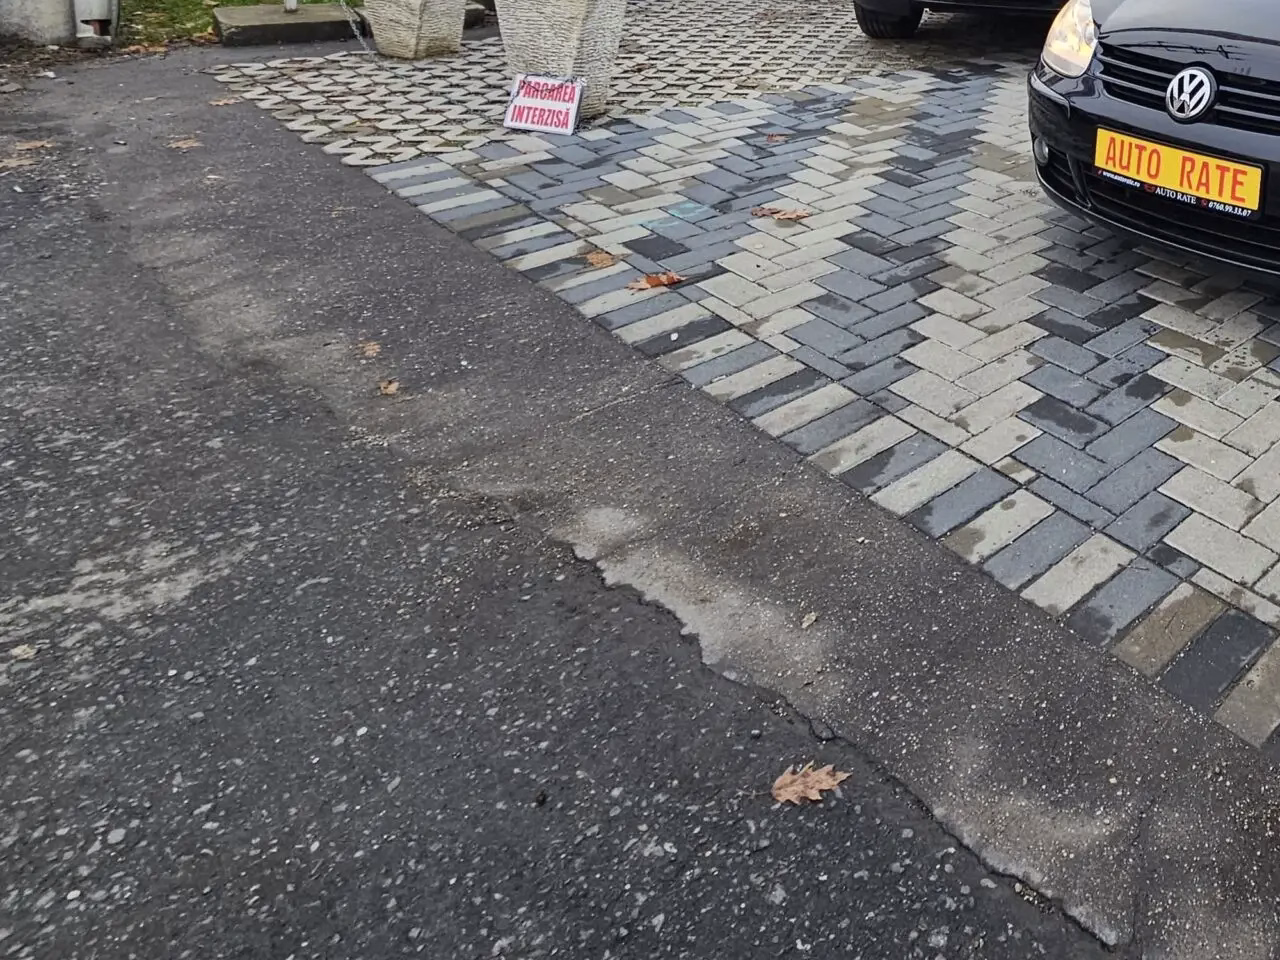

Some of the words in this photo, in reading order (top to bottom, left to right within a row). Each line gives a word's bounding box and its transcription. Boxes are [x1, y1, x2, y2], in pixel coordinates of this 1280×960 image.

[519, 79, 577, 104] PARCAREA
[1105, 136, 1161, 180] AUTO
[1179, 155, 1248, 203] RATE
[1155, 186, 1176, 200] AUTO
[1177, 192, 1197, 205] RATE
